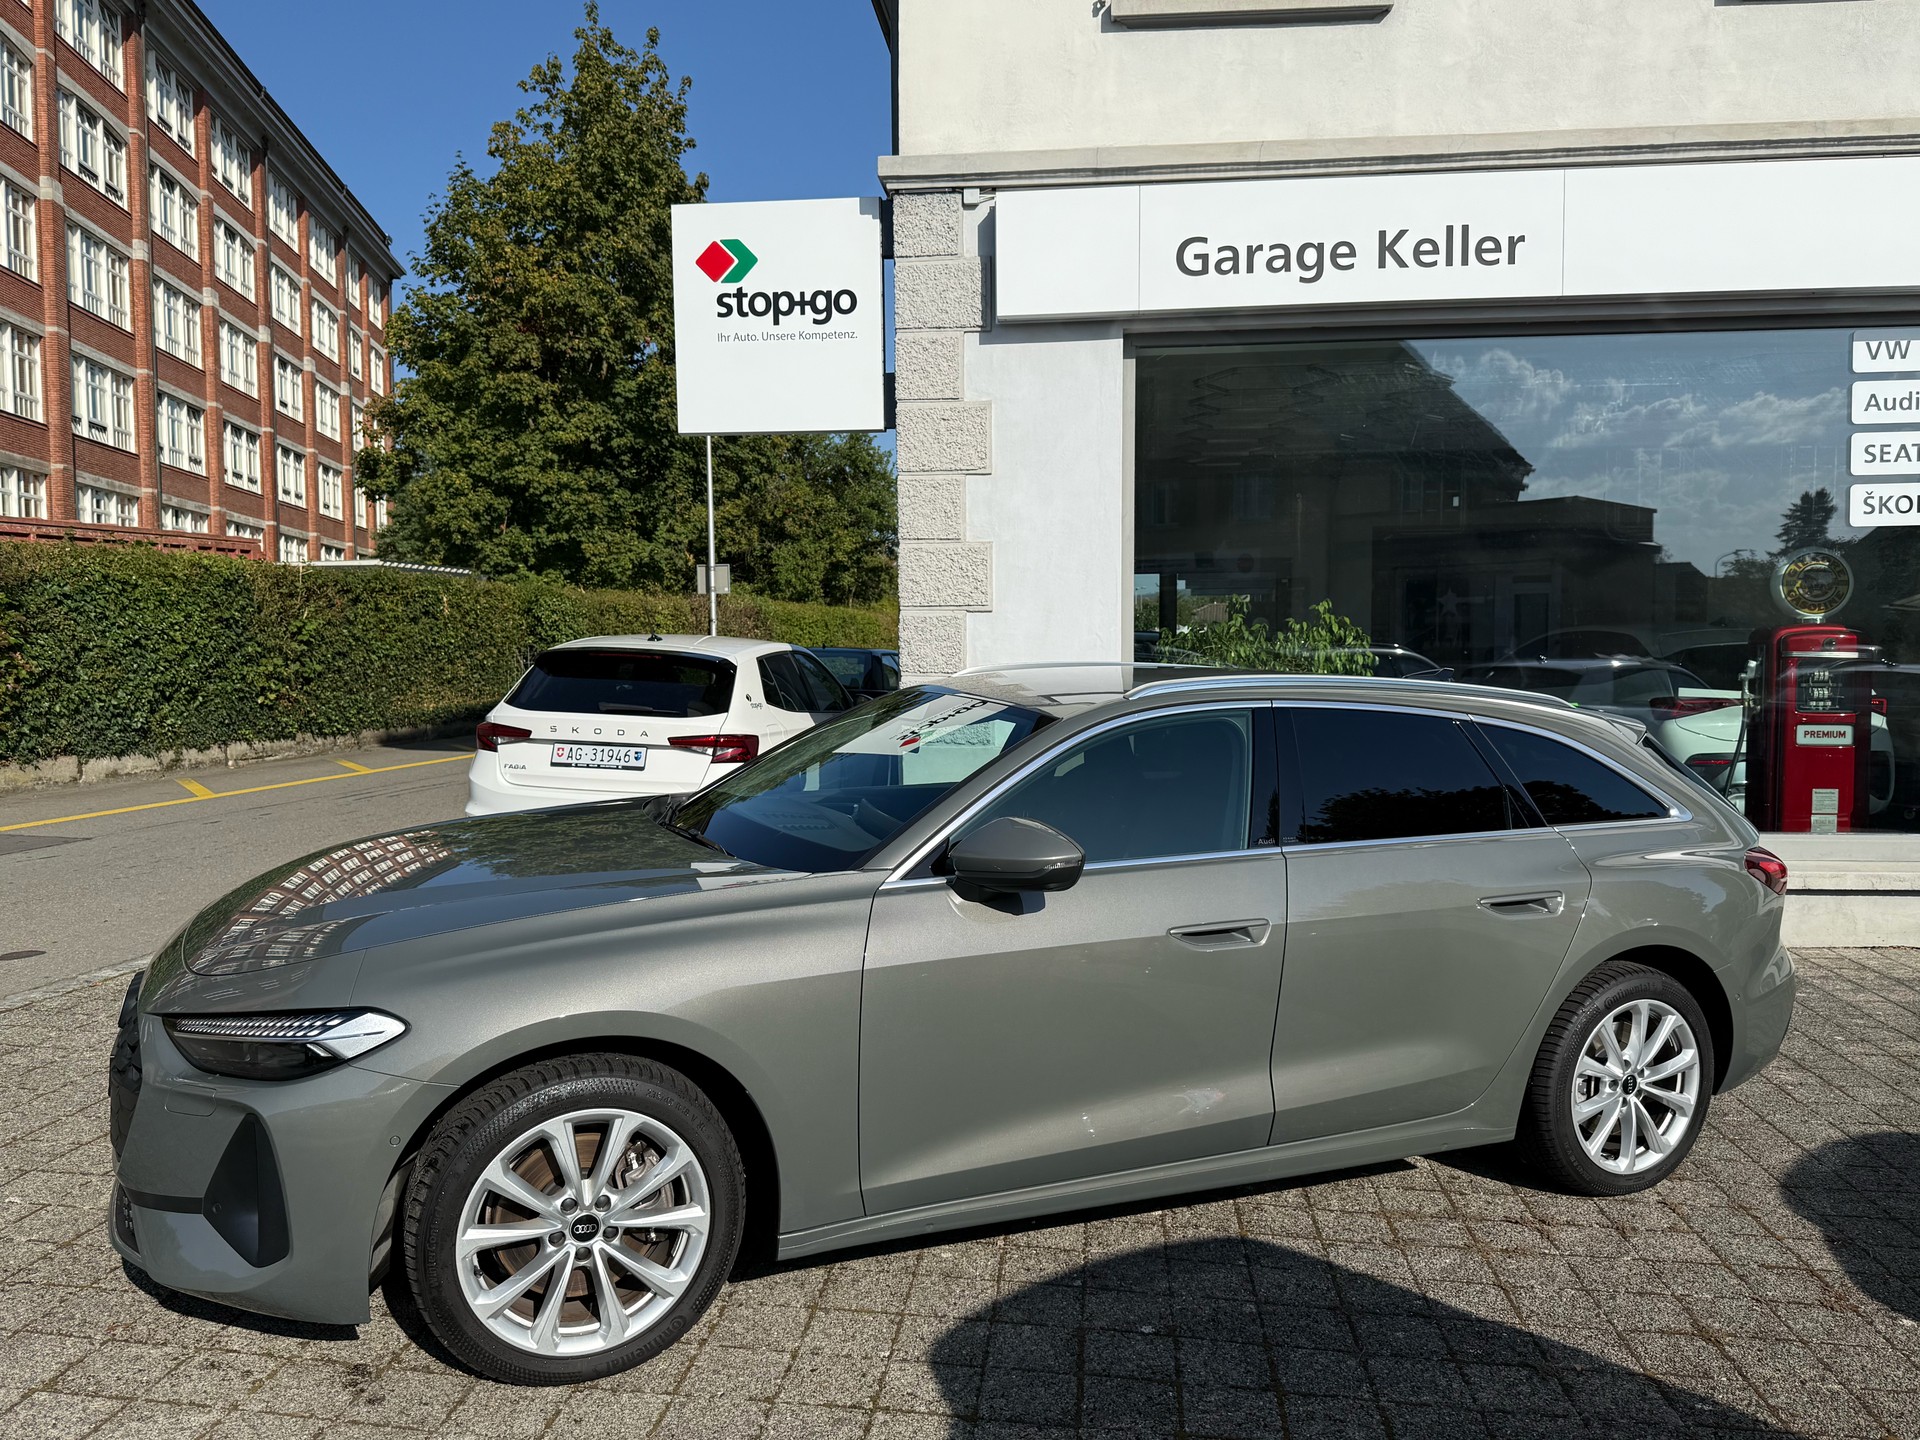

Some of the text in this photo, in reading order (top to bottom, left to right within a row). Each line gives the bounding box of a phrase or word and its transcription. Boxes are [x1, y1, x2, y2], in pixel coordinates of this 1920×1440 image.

[1175, 224, 1525, 284] Garage Keller
[716, 286, 858, 326] stop+go
[717, 330, 858, 342] Ihr Auto. Unsere Kompetenz.
[1865, 340, 1911, 361] VW
[1864, 391, 1920, 412] Audi
[1863, 491, 1920, 515] ŠKO
[550, 725, 649, 738] SKODA
[1803, 730, 1847, 739] PREMIUM
[1258, 837, 1276, 845] Audi
